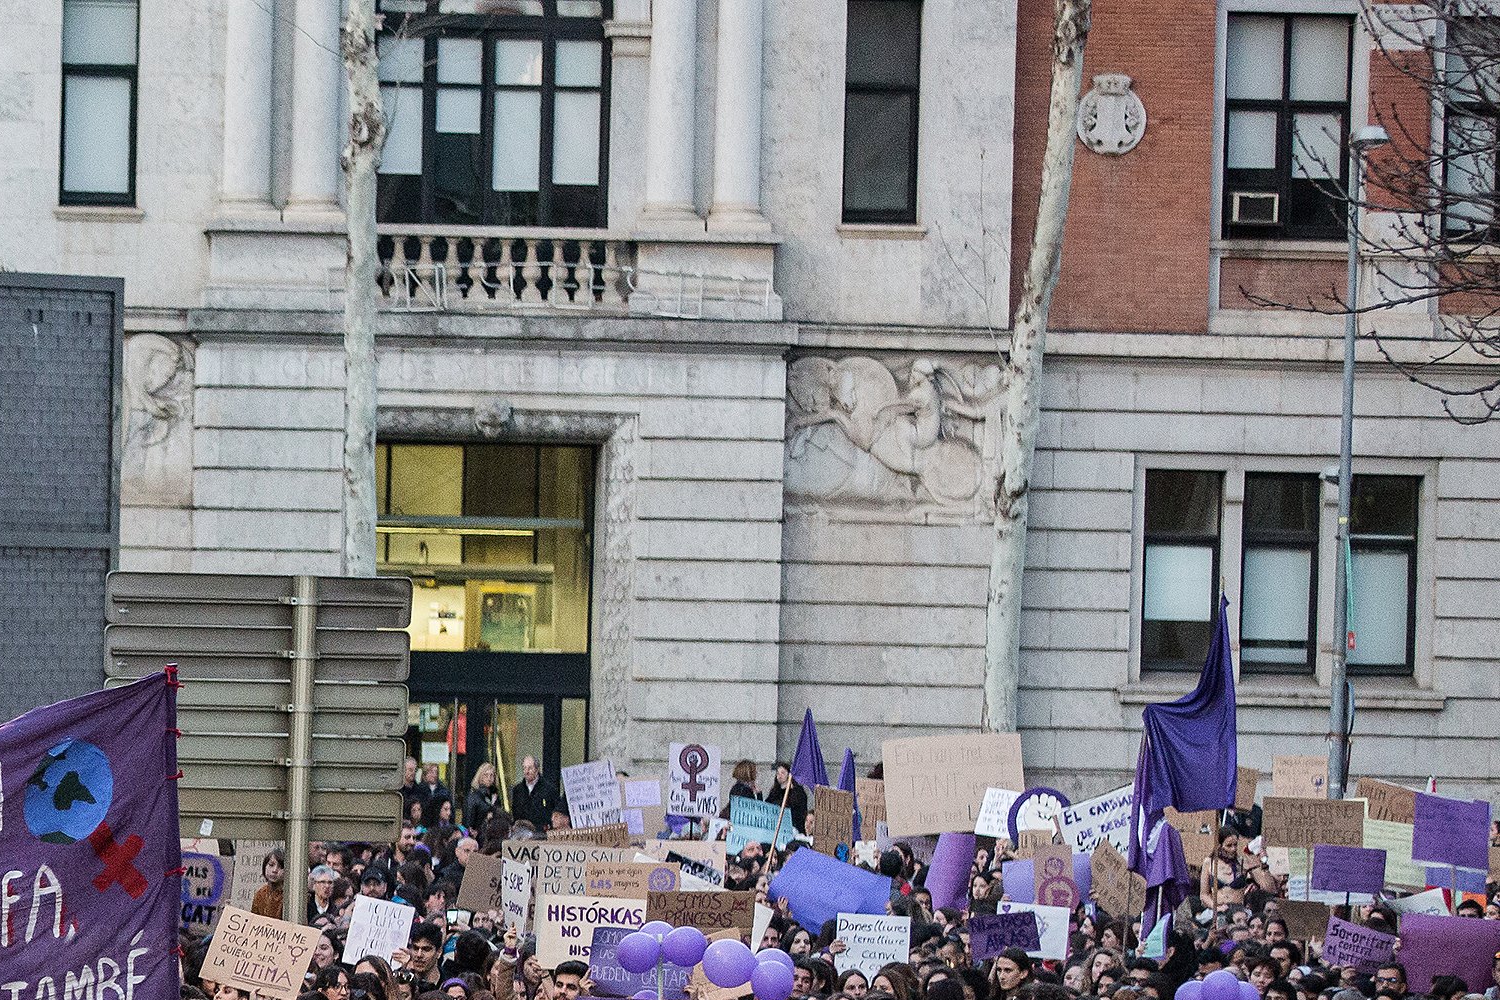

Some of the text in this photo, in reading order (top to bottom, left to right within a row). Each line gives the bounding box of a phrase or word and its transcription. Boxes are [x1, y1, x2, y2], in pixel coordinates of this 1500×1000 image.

[1063, 810, 1083, 826] EL
[508, 846, 539, 864] VAG
[544, 849, 563, 863] YO
[565, 850, 587, 863] NO
[544, 865, 582, 880] DE TU
[568, 882, 586, 896] SA
[591, 878, 612, 889] LAS
[649, 893, 722, 911] NO SOMOS
[662, 910, 734, 929] PRINCESAS
[839, 918, 908, 934] Dones lliures
[222, 931, 248, 948] TOCA
[251, 940, 259, 950] A
[249, 923, 288, 945] MAÑANA
[291, 932, 308, 945] ME
[561, 926, 582, 939] NO
[1330, 923, 1392, 950] Sororitat
[220, 944, 277, 966] QUIERO SER
[568, 944, 592, 957] HIS
[861, 948, 897, 960] canvi
[1326, 944, 1338, 957] el
[1338, 940, 1374, 958] contra
[213, 956, 227, 968] LA
